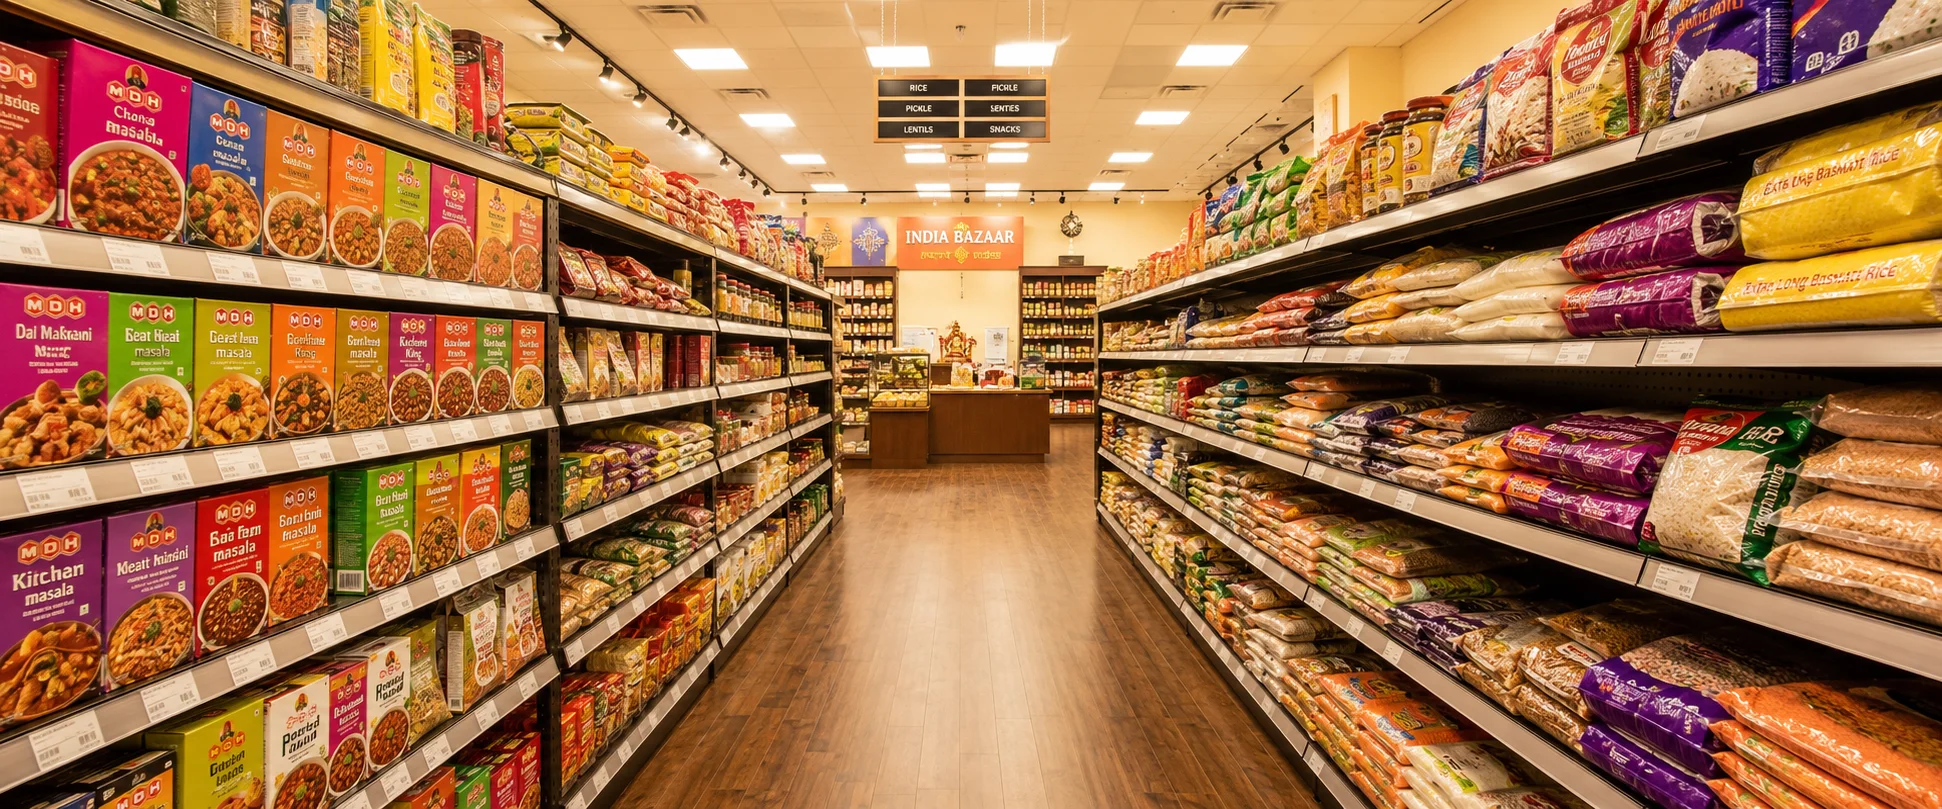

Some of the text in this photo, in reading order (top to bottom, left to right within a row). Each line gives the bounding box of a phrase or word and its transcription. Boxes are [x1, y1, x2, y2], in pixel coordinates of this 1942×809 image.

[909, 84, 928, 92] RICE
[109, 84, 159, 108] MDH
[905, 104, 933, 113] PICKLE
[903, 125, 934, 134] LENTILS
[989, 125, 1021, 134] SNACKS
[905, 229, 1015, 244] INDIA BAZAAR
[27, 299, 83, 313] MDH
[131, 306, 174, 320] MDH
[215, 311, 254, 325] MDH
[289, 313, 323, 327] MDH
[216, 502, 255, 521] MDH
[132, 528, 176, 549] MDH
[21, 536, 78, 560] MDH
[213, 539, 256, 563] masala
[25, 582, 74, 607] masala
